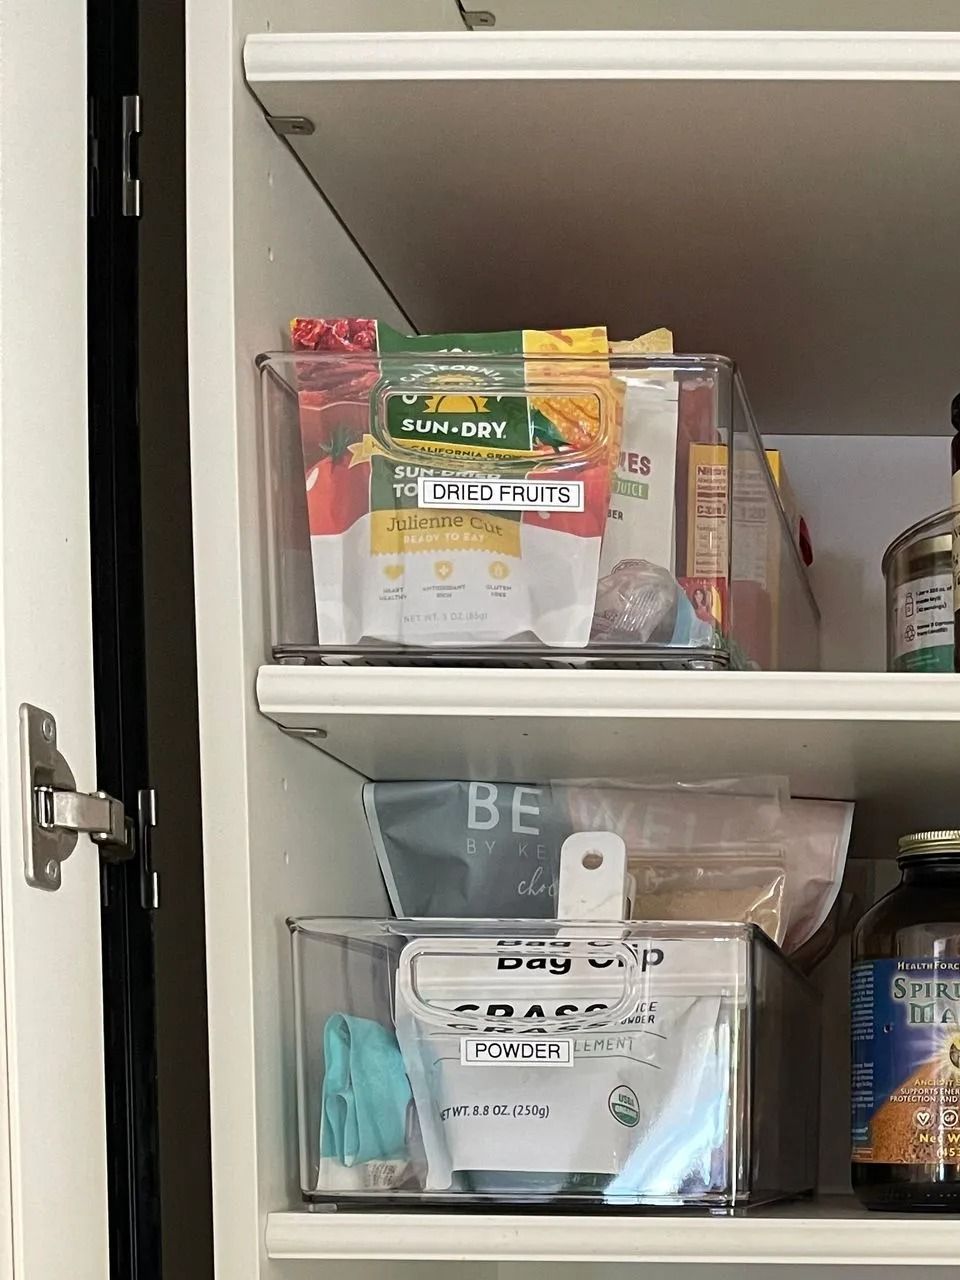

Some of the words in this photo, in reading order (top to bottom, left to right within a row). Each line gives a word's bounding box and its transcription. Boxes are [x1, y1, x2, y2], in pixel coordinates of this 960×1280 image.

[433, 484, 493, 501] DRIED
[500, 485, 570, 503] FRUITS
[616, 480, 643, 496] JUICE
[387, 515, 464, 532] Julienne
[469, 517, 504, 536] Cut
[403, 533, 439, 544] READY
[445, 533, 459, 542] TO
[463, 533, 484, 543] EAT
[467, 782, 543, 835] BE
[466, 840, 497, 854] BY
[475, 1043, 561, 1059] POWDER
[453, 1105, 470, 1117] WT.
[473, 1105, 489, 1116] 8.8
[493, 1105, 510, 1116] OZ.
[513, 1104, 549, 1118] (250g)
